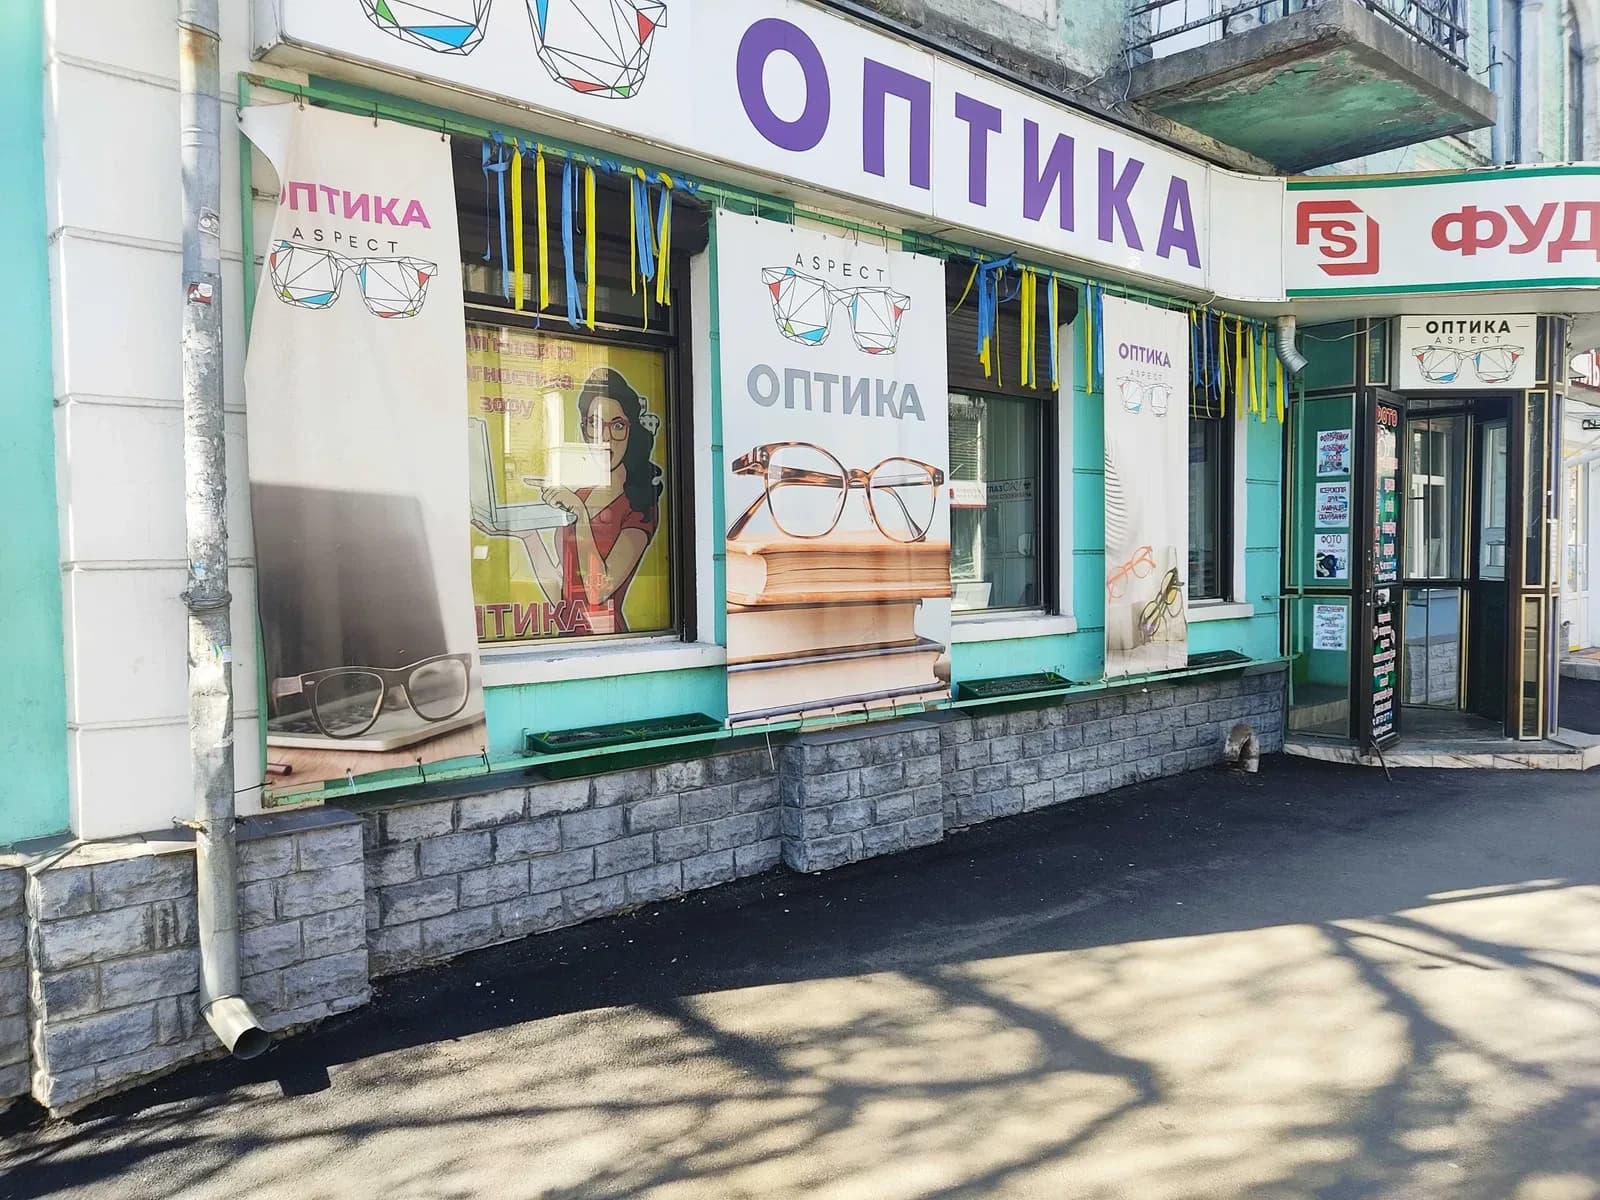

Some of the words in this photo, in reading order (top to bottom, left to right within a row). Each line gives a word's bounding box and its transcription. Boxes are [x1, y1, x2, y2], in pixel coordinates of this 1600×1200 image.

[736, 17, 1202, 269] ОПТИКА
[280, 181, 431, 229] ПТИКА
[292, 227, 399, 253] ASPECT
[795, 253, 884, 282] ASPECT
[1425, 320, 1511, 334] ОПТИКА
[1434, 335, 1502, 344] ASPECT
[1118, 342, 1172, 369] ОПТИКА
[747, 363, 926, 422] ОПТИКА
[1321, 534, 1342, 544] ФОТО
